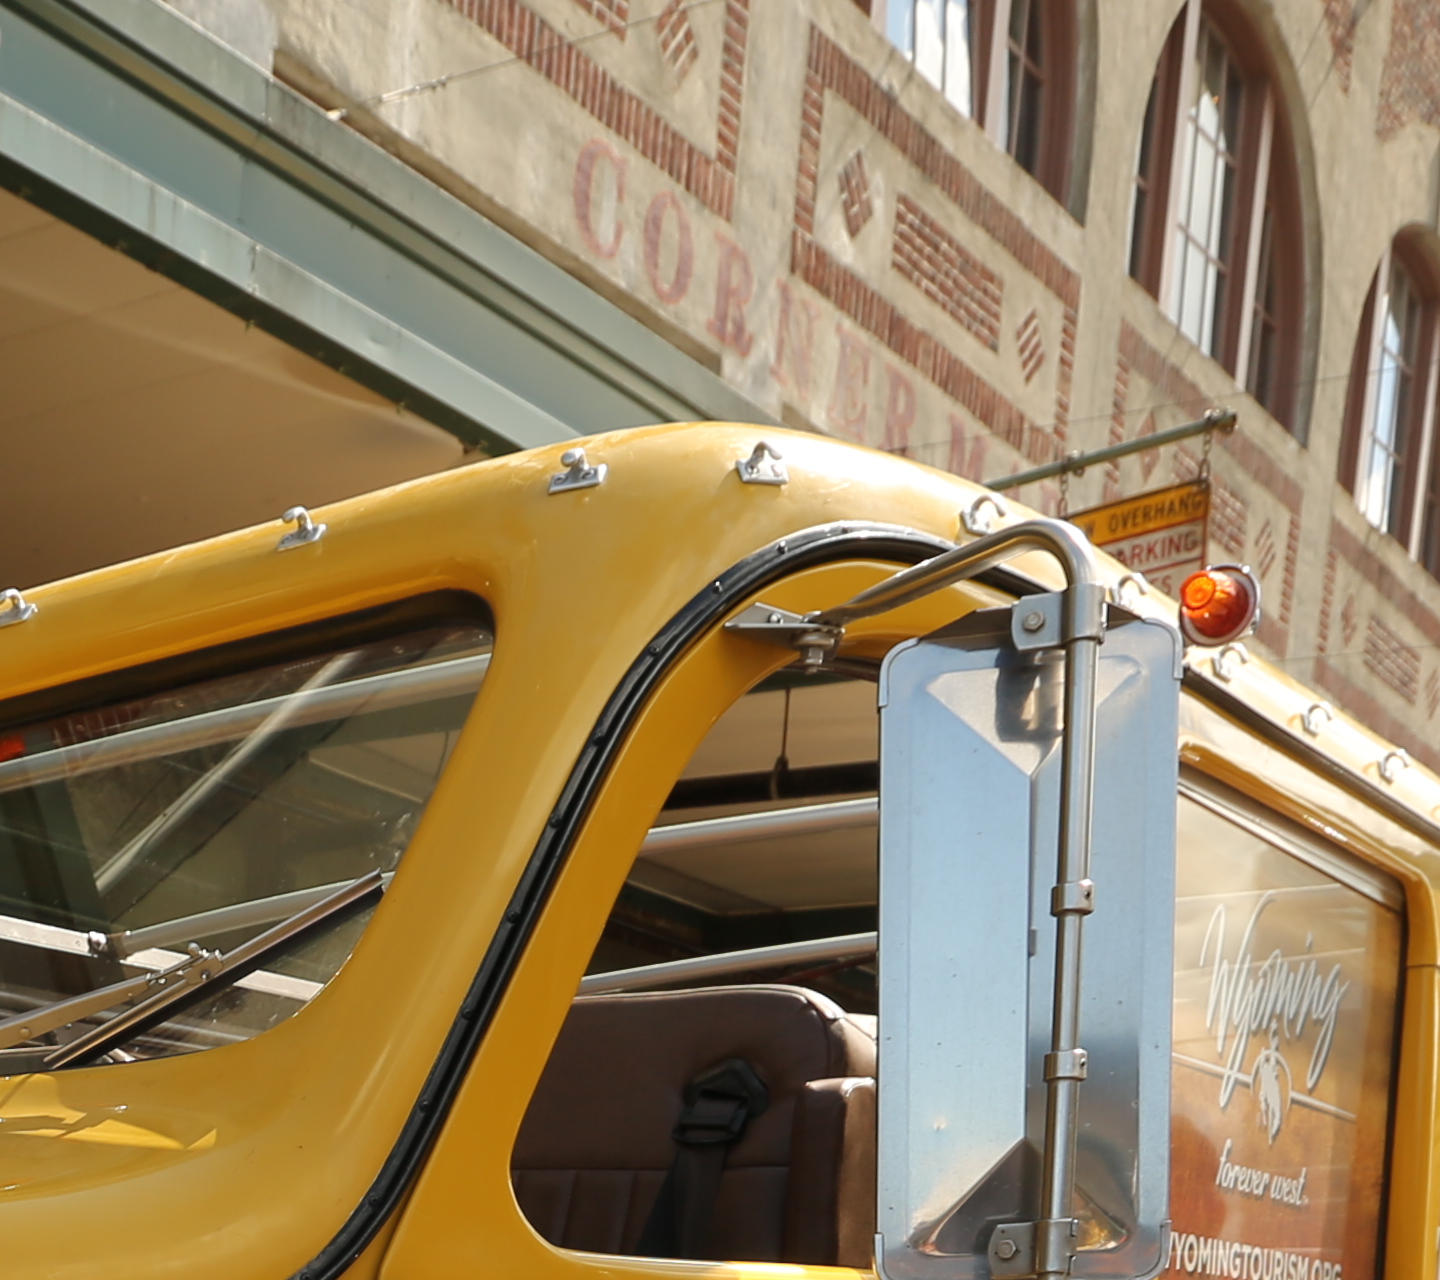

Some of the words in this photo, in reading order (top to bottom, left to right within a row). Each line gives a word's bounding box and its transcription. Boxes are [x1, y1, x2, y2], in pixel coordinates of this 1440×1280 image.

[573, 137, 919, 454] CORNER
[1108, 492, 1202, 533] OVERHANG
[1200, 890, 1350, 1108] Wyoming
[1215, 1139, 1269, 1197] forever
